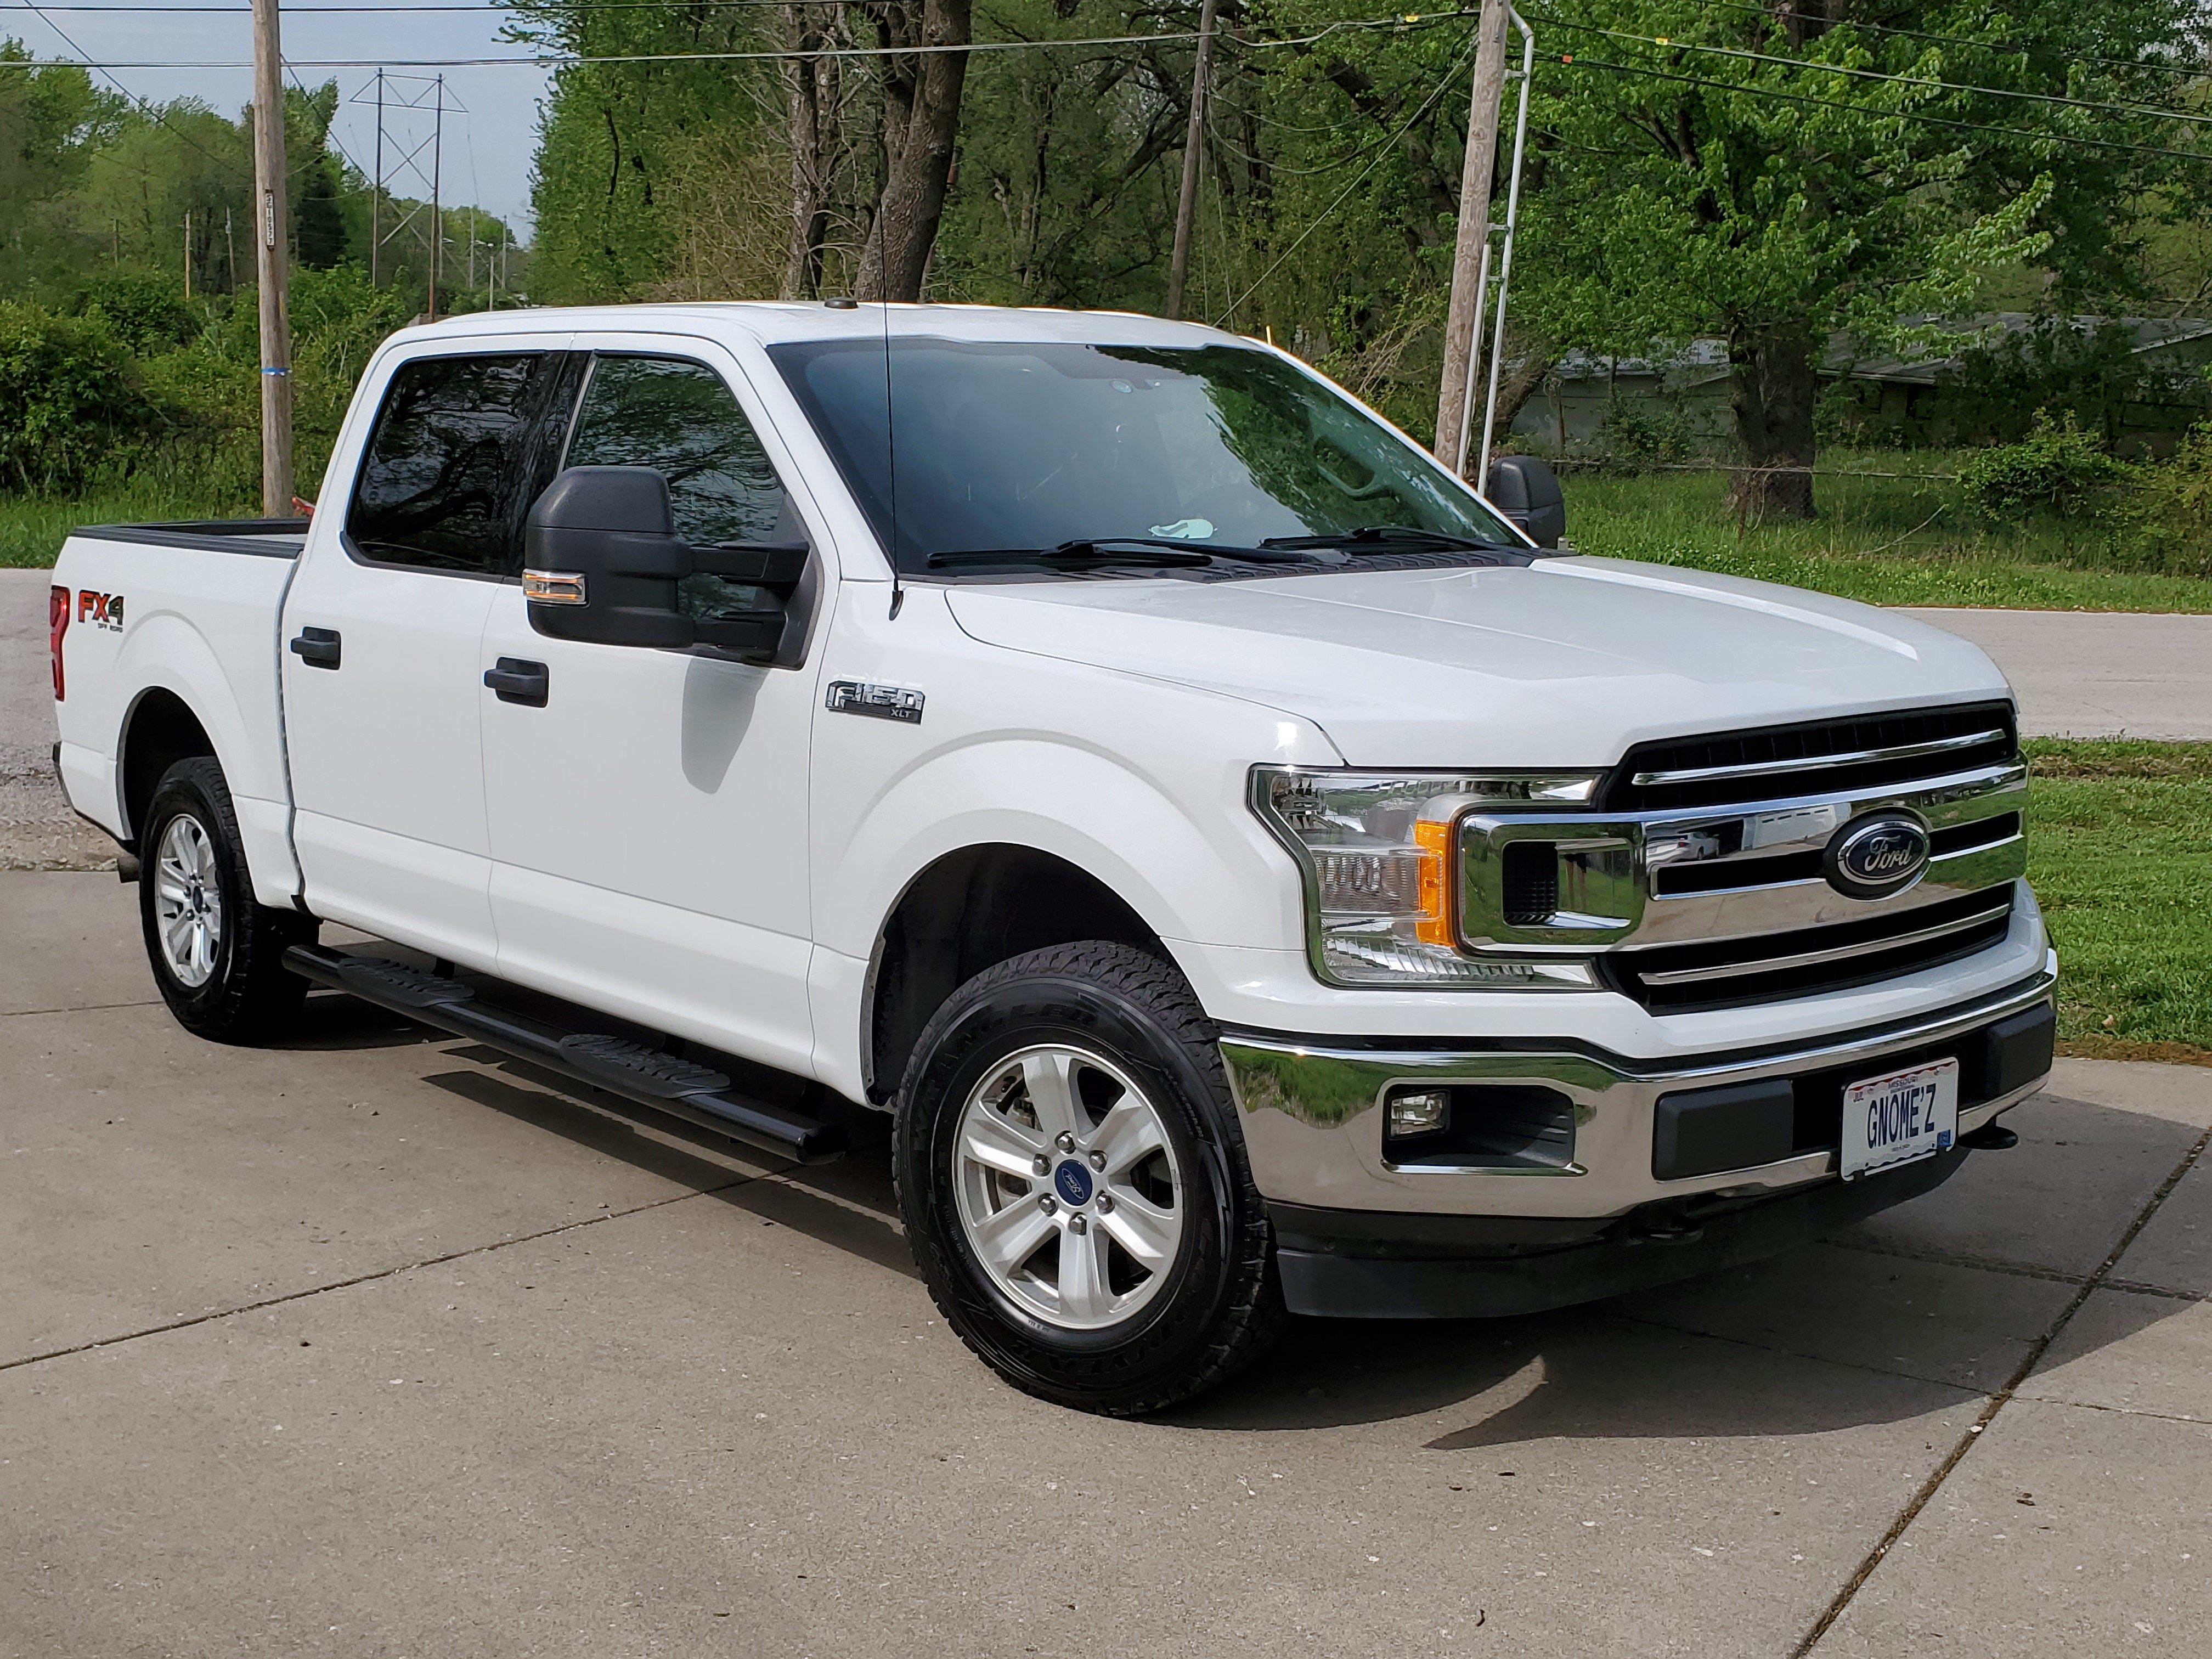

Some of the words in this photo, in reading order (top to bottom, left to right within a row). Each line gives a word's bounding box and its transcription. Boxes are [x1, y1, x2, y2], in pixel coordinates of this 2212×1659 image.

[78, 590, 124, 625] FX4
[890, 708, 911, 718] XLT
[1864, 835, 1913, 872] Ford
[1867, 1083, 1936, 1149] GNOME'Z
